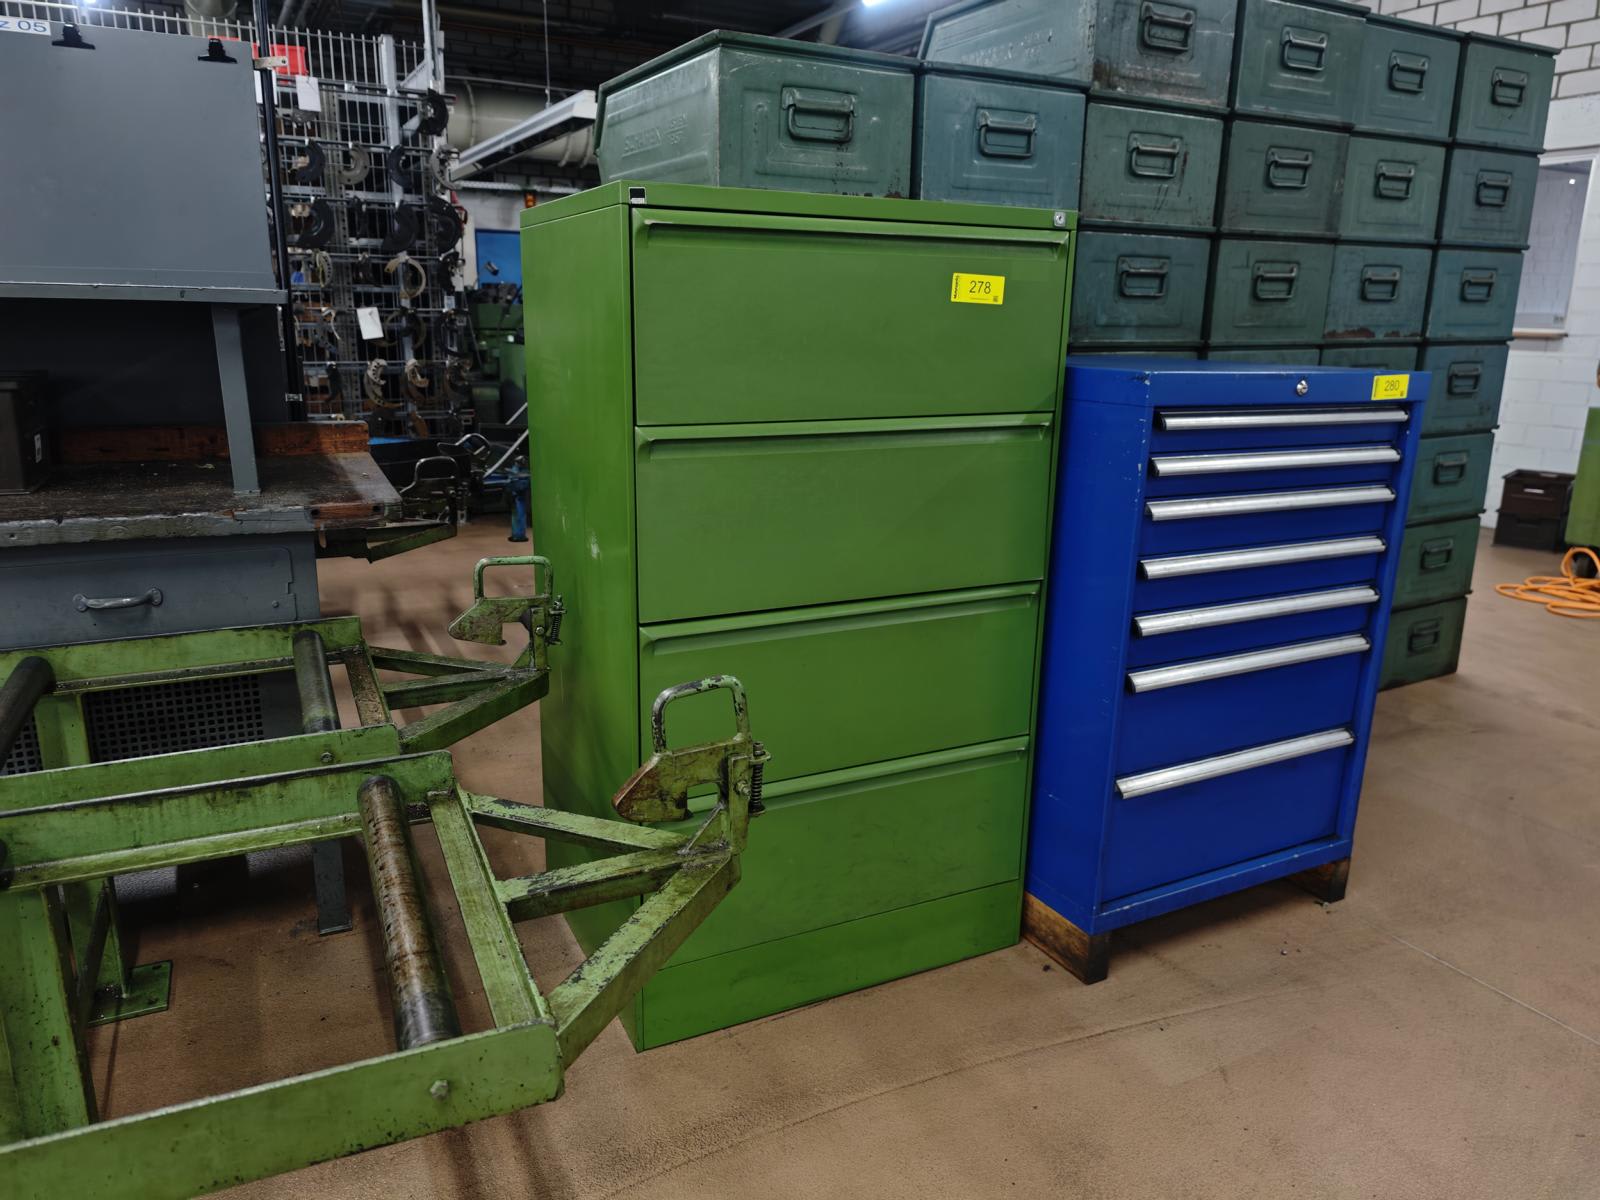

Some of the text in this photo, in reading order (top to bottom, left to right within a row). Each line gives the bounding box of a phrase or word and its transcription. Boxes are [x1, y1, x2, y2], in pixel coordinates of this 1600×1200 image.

[17, 20, 47, 32] 05
[969, 280, 992, 295] 278
[1384, 379, 1400, 392] 280
